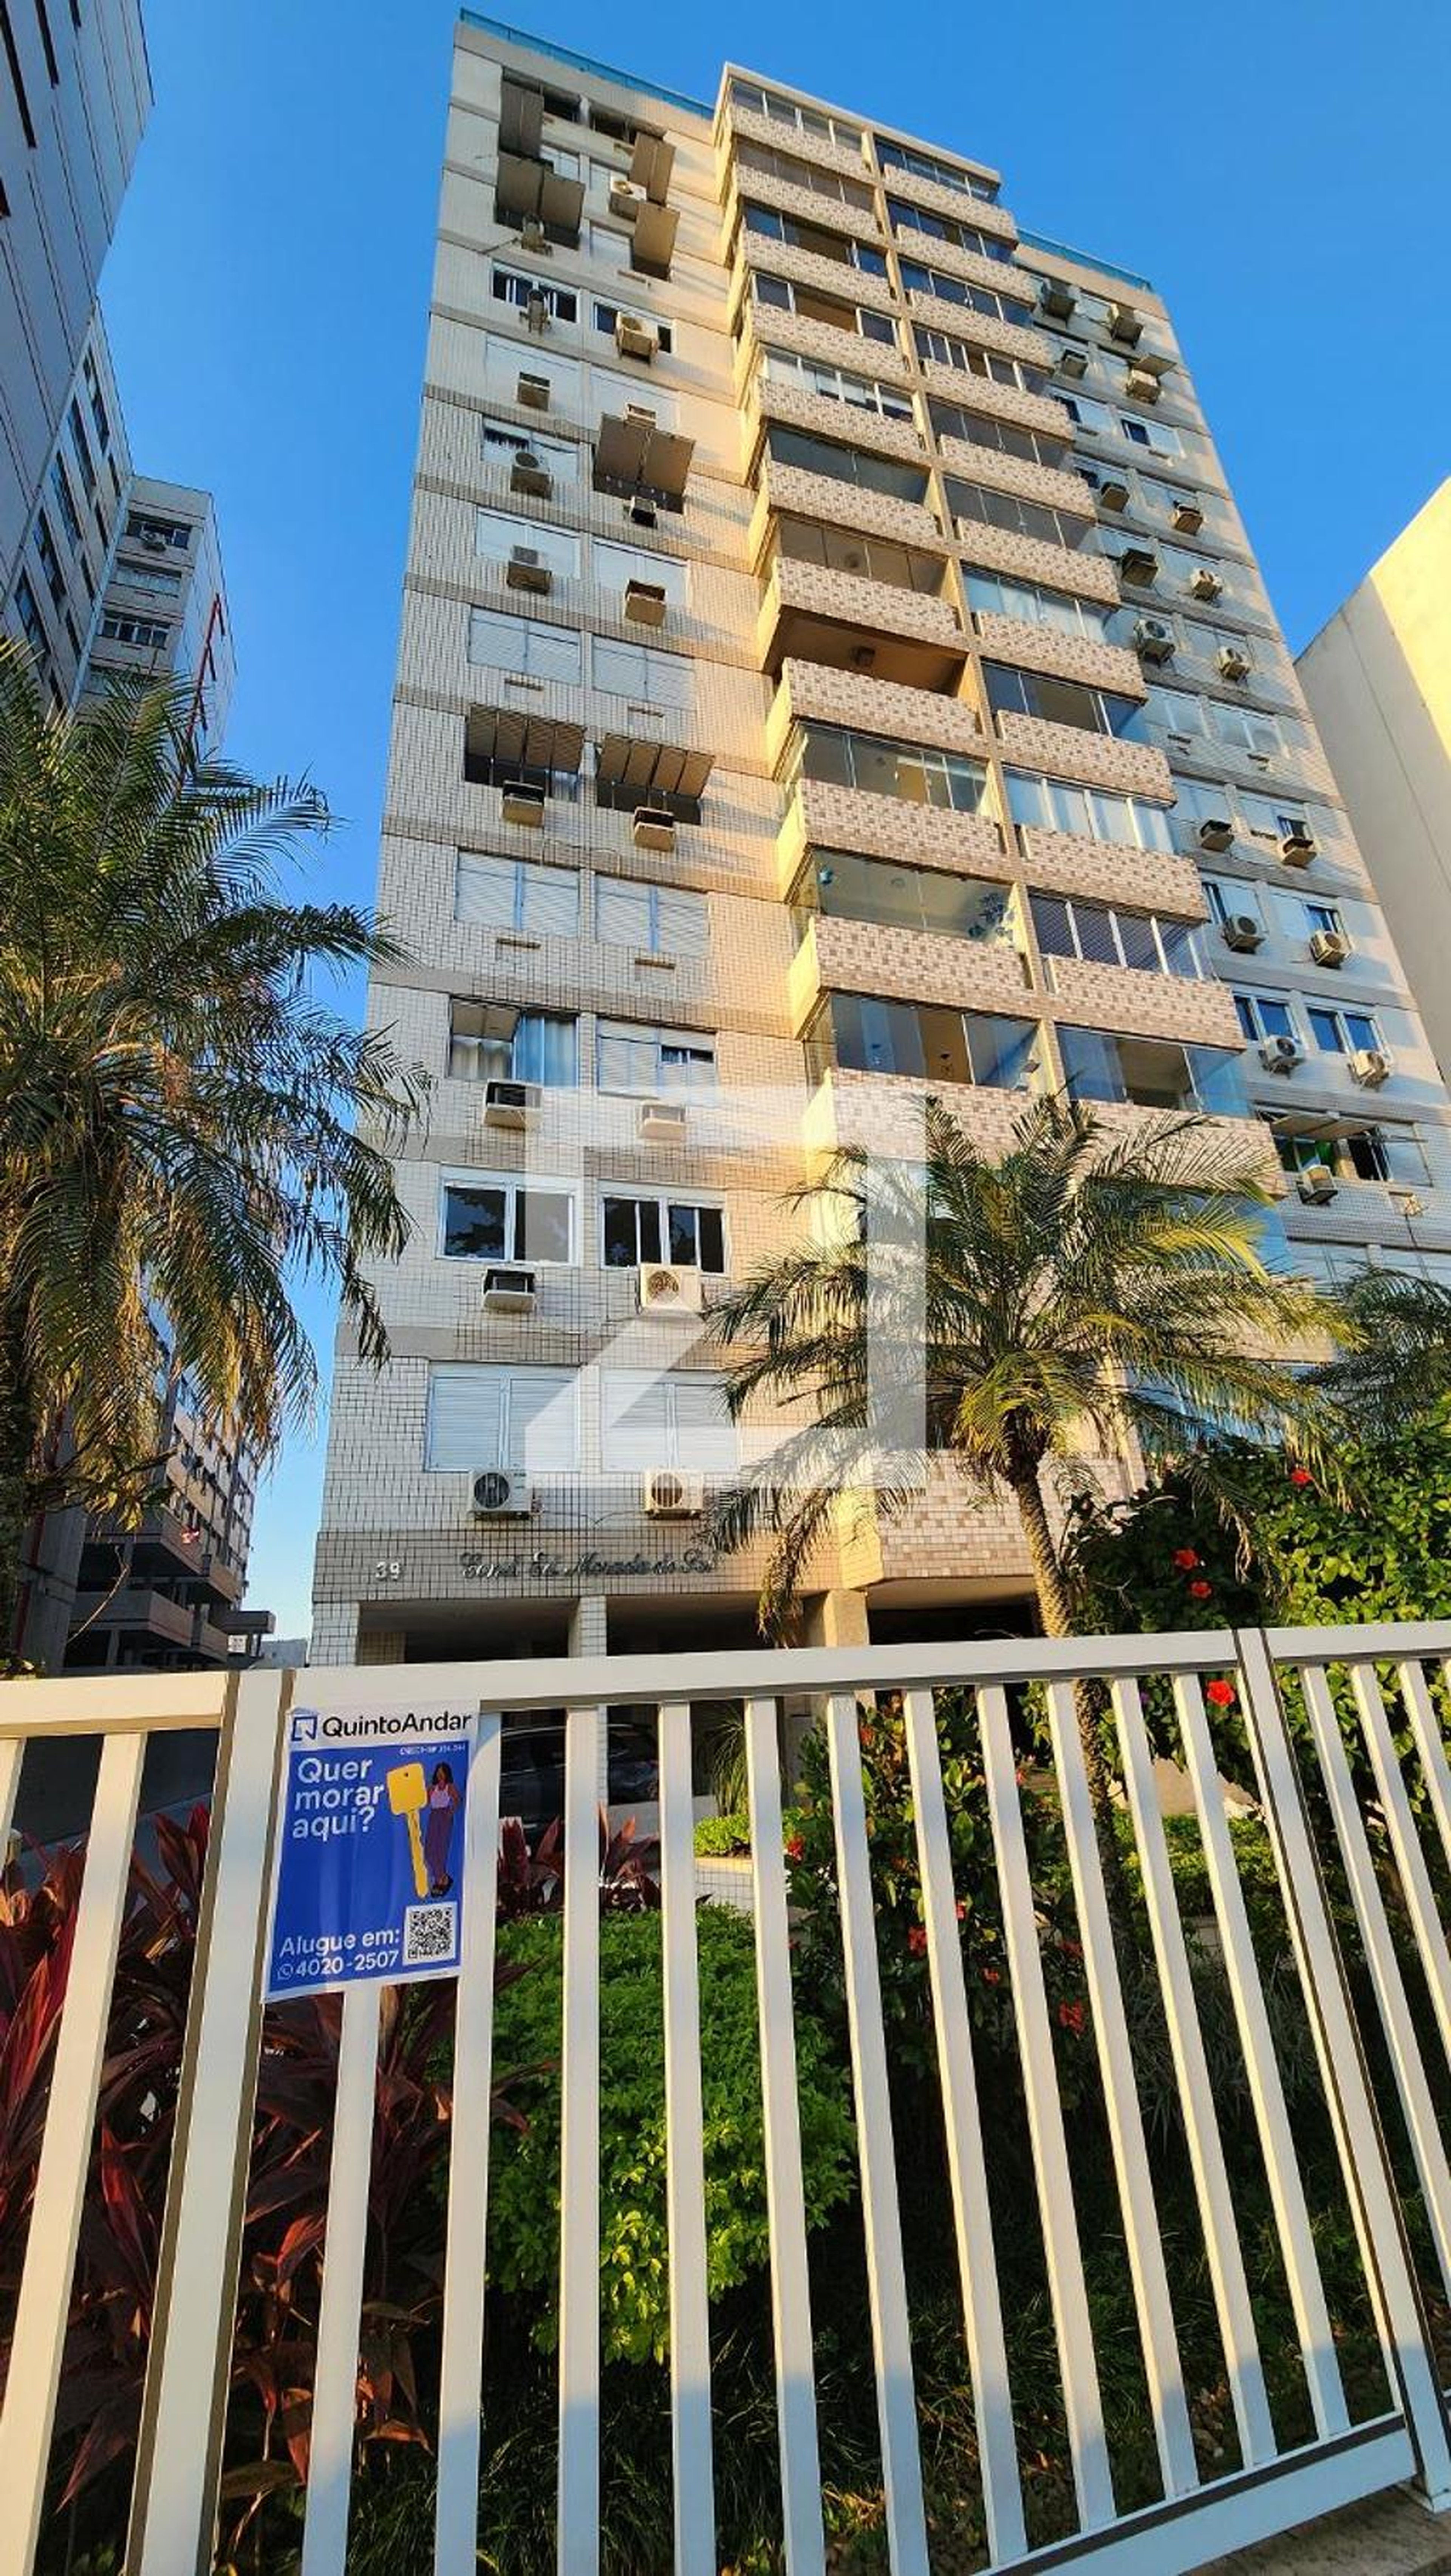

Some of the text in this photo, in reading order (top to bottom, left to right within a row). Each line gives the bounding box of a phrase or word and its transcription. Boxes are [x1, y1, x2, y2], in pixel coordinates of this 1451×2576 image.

[375, 1561, 400, 1580] 39
[322, 1712, 472, 1738] QuintoAndar
[297, 1757, 373, 1784] Quer
[294, 1784, 385, 1811] morar
[292, 1806, 375, 1842] aqui?
[279, 1928, 400, 1959] Alugue em:
[295, 1950, 399, 1977] 4020-2507
